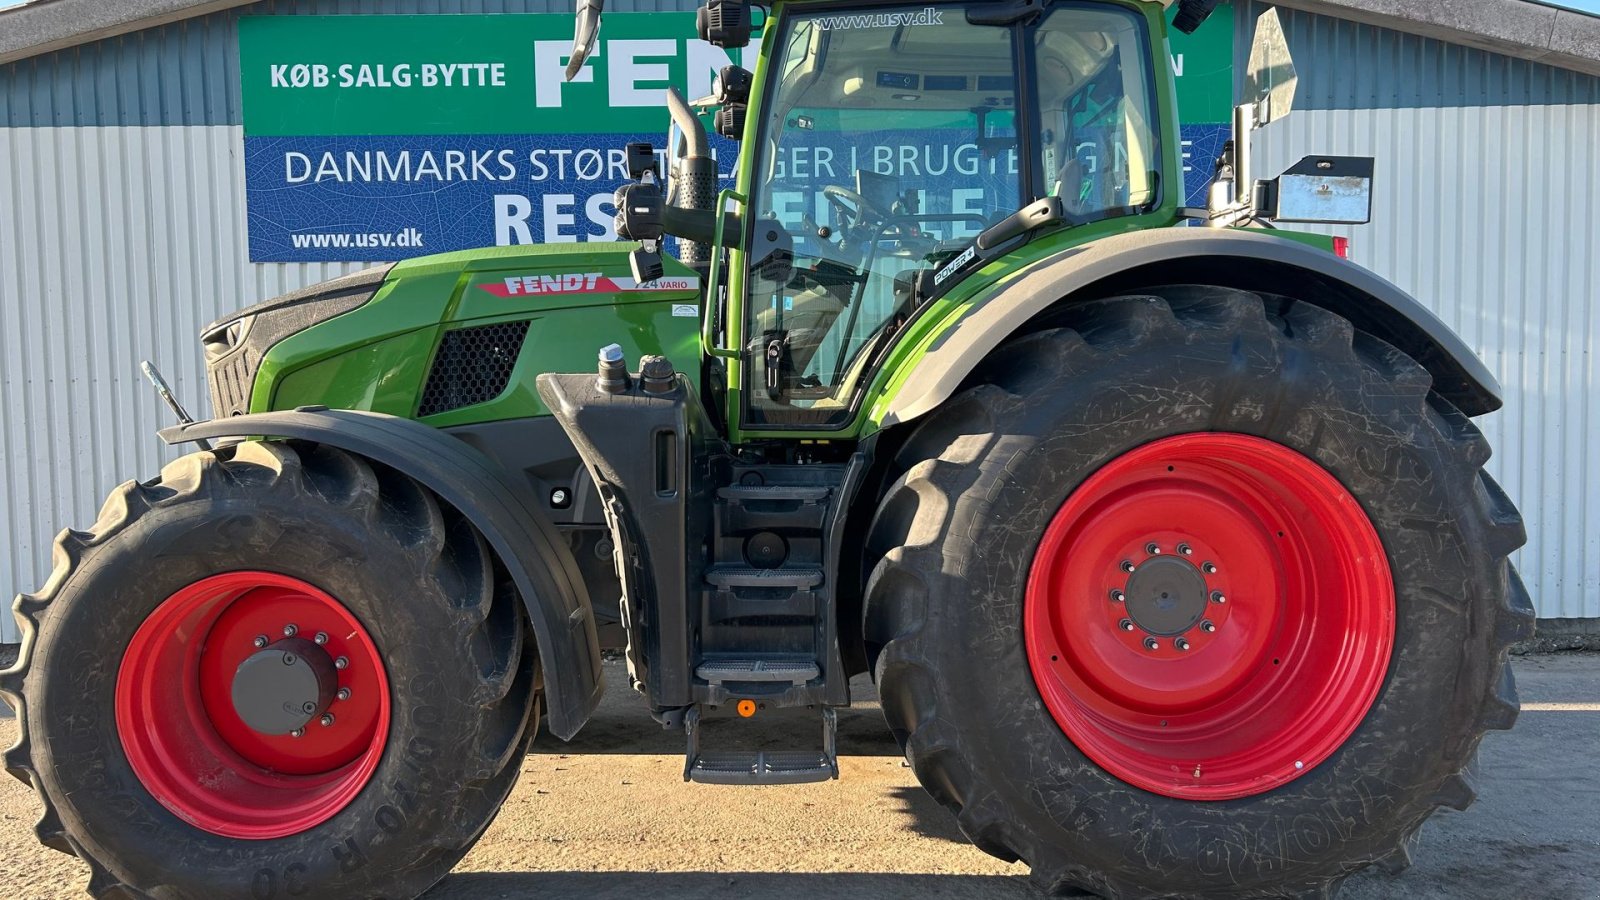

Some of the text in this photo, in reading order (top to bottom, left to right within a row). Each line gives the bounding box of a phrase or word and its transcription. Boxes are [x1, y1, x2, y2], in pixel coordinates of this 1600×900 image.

[810, 7, 943, 31] www.usv.dk
[285, 149, 516, 183] DANMARKS
[291, 227, 423, 248] www.usv.dk
[935, 254, 967, 283] POWER
[504, 272, 603, 294] FENDT
[660, 281, 688, 289] VARIO
